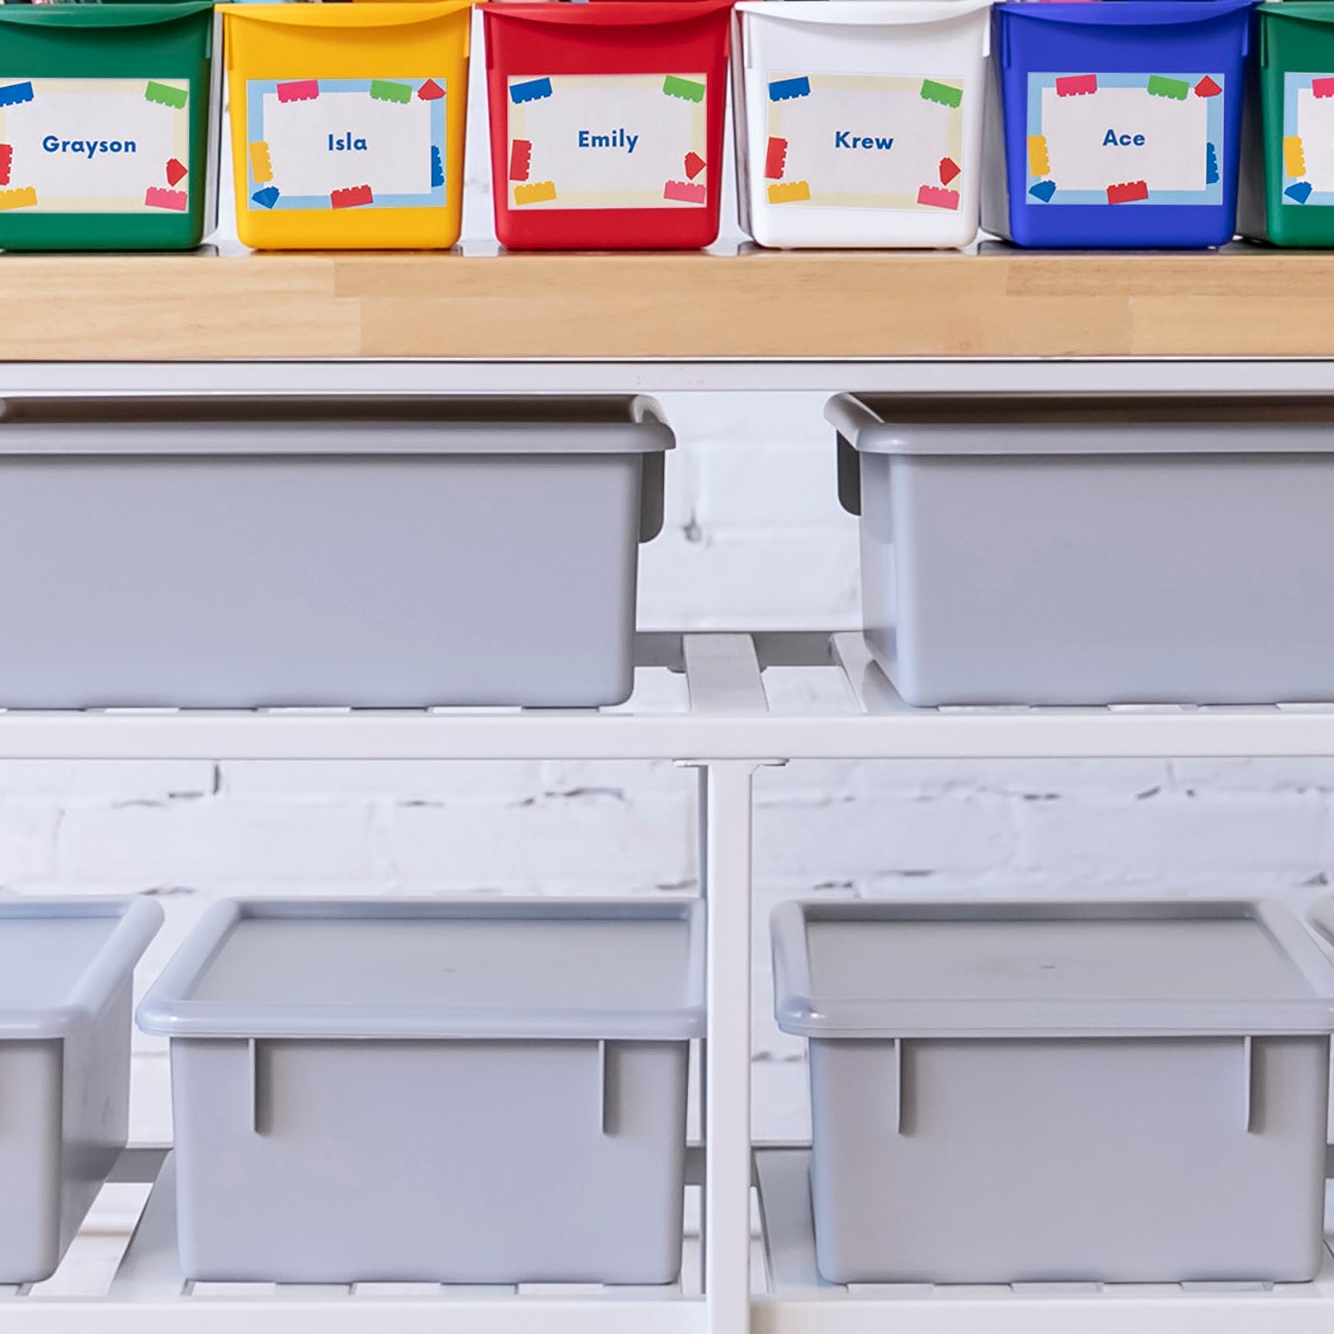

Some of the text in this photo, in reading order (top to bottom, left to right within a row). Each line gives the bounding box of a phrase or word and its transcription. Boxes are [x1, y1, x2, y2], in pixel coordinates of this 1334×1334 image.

[42, 134, 137, 160] Grayson
[328, 131, 368, 152] Isla
[578, 128, 639, 154] Emily
[834, 130, 894, 151] Krew
[1102, 128, 1146, 147] Ace
